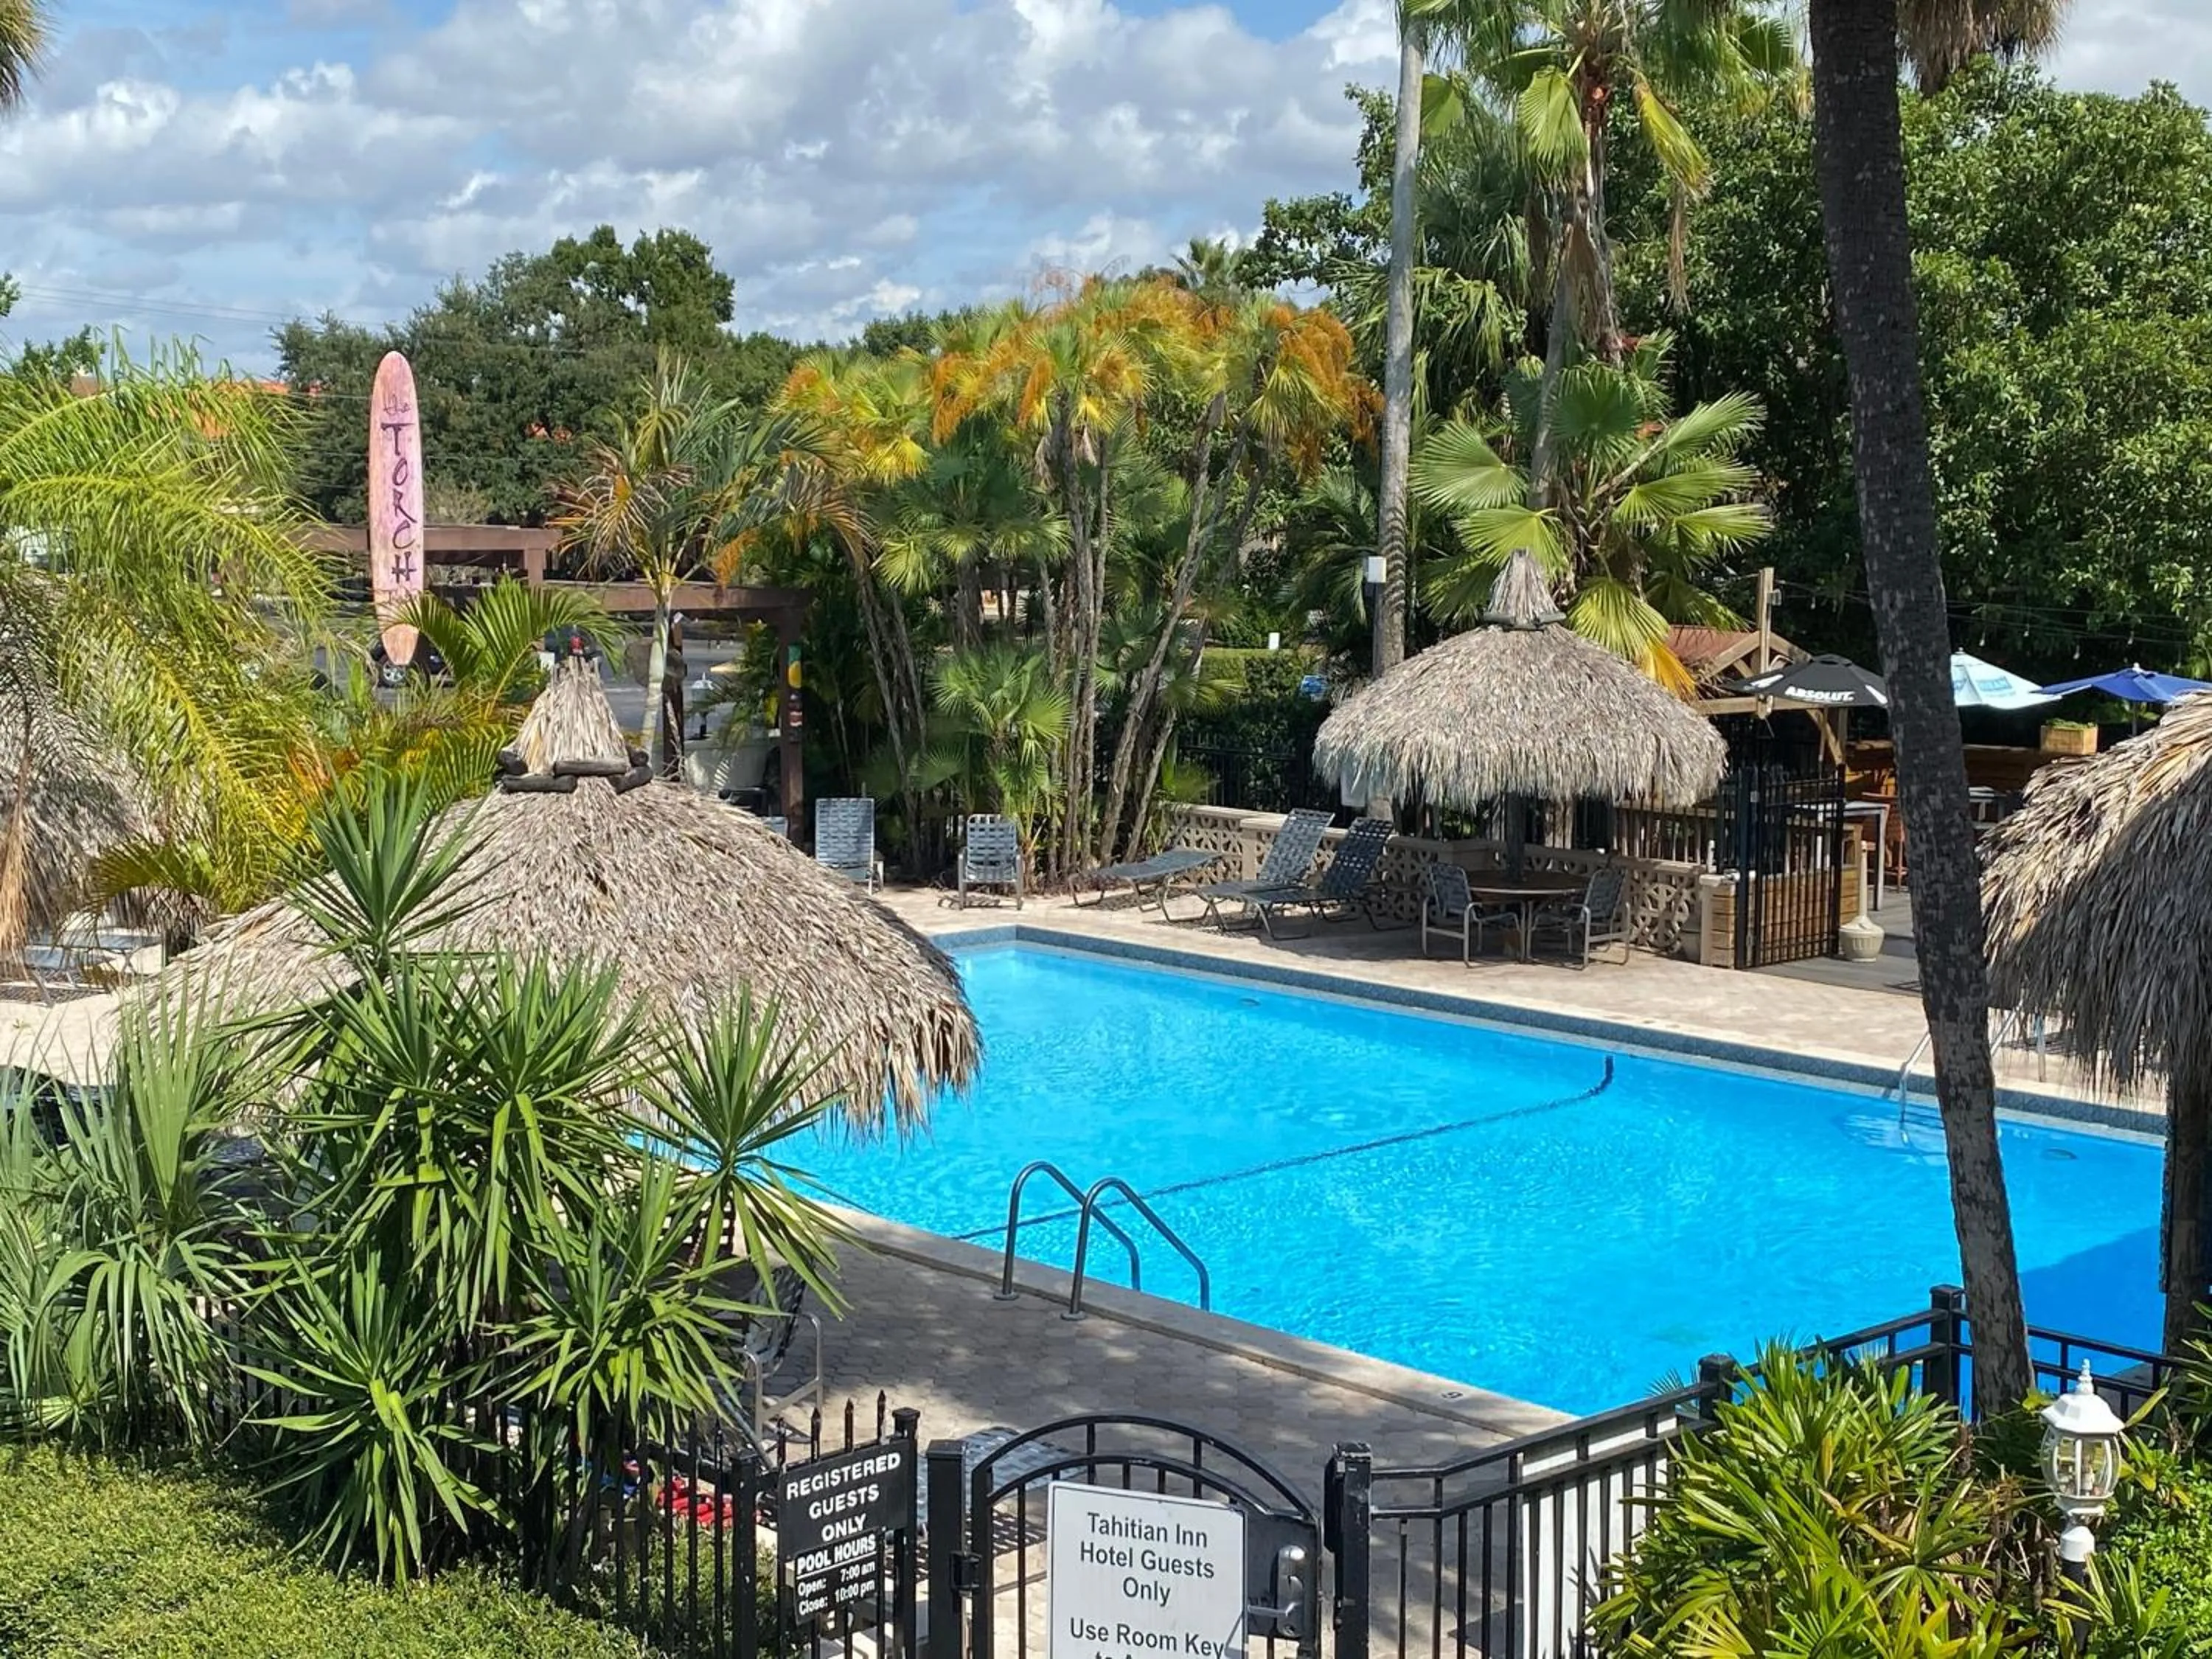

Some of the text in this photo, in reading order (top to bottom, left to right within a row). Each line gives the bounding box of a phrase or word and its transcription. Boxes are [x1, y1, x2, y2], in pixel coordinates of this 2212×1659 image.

[380, 422, 417, 584] TORCH
[786, 1452, 901, 1500] REGISTERED
[809, 1484, 880, 1520] GUESTS
[821, 1513, 866, 1542] ONLY
[1088, 1512, 1208, 1548] Tahitian Inn
[796, 1534, 877, 1575] POOL HOURS
[1080, 1541, 1215, 1579] Hotel Guests
[798, 1561, 875, 1597] Open: 7:00 am
[799, 1579, 875, 1615] Close: 10:00 pm
[1123, 1576, 1171, 1607] Only
[1070, 1617, 1224, 1659] Use Room Key
